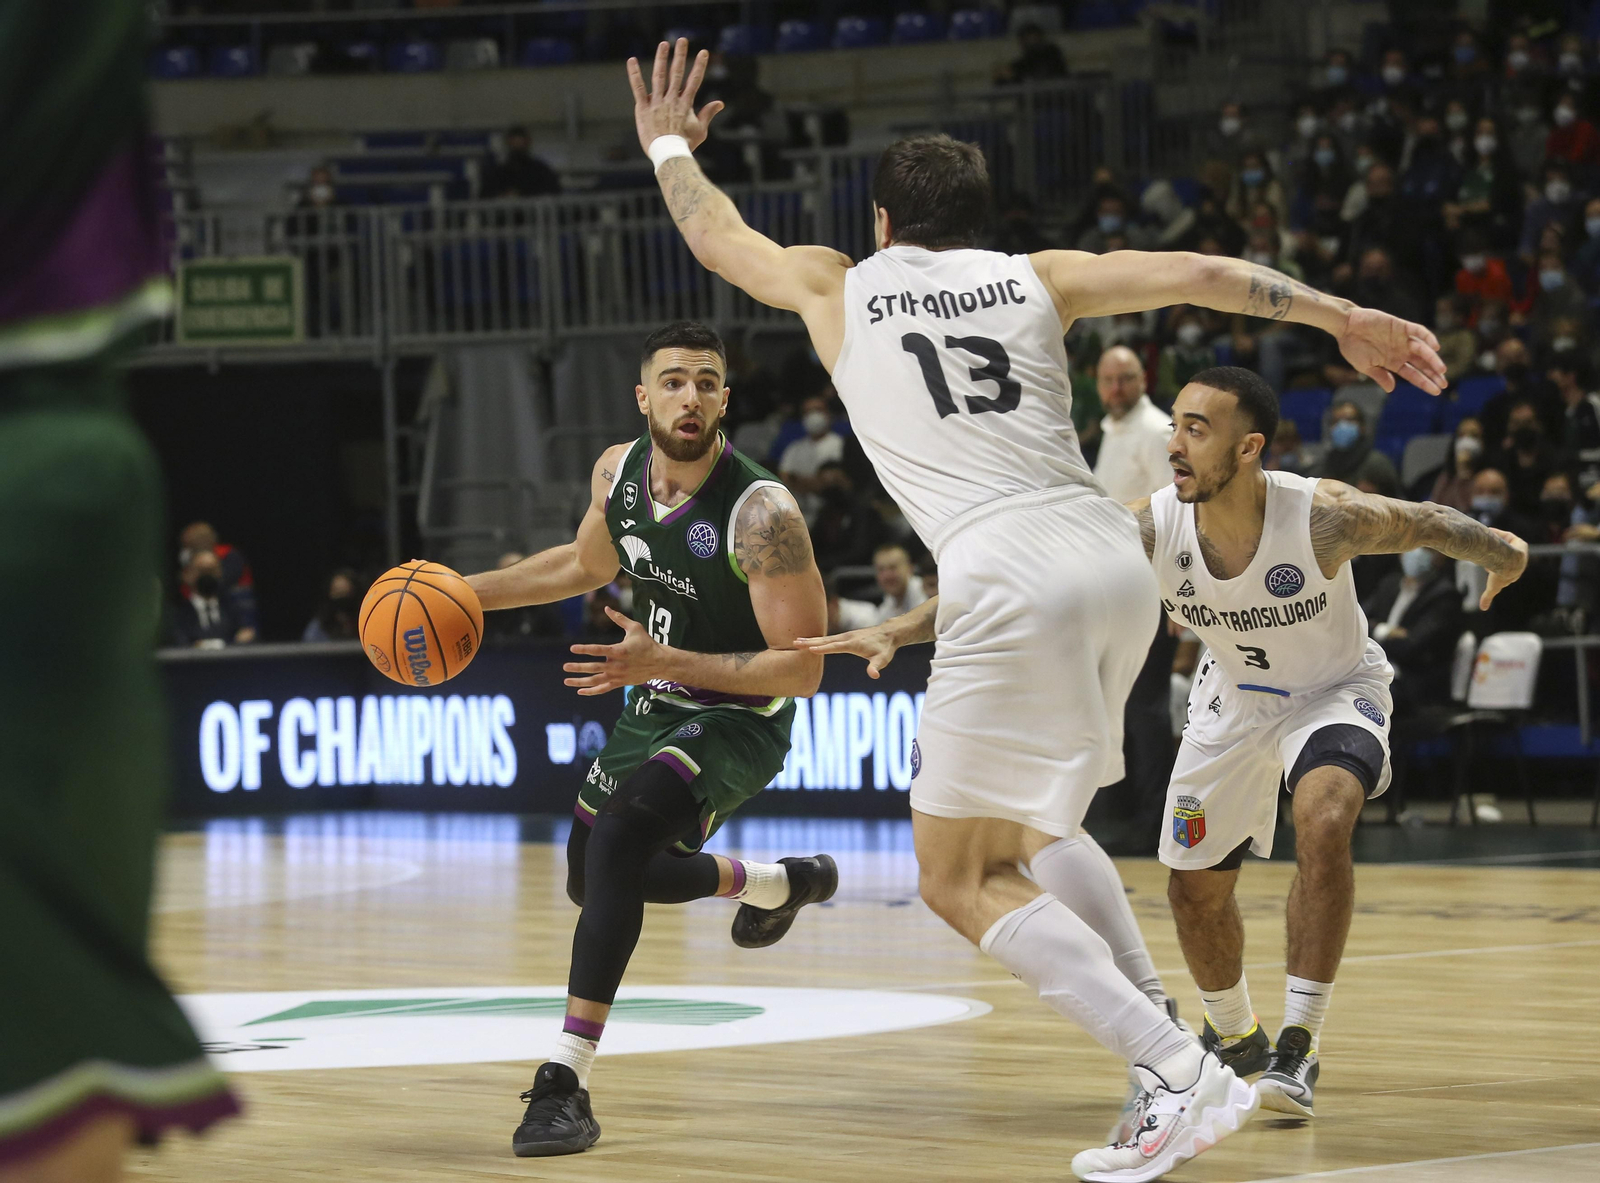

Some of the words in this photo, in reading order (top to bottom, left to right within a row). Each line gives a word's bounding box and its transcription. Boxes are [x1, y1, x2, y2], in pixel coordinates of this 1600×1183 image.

[901, 332, 1022, 419] 13
[649, 563, 697, 595] Unicaja
[1178, 603, 1222, 627] ANCA
[1219, 591, 1327, 632] TRANSILVANIA
[460, 632, 473, 658] FIBA
[1235, 643, 1271, 670] 3
[200, 700, 273, 793] OF
[277, 693, 518, 789] CHAMPIONS
[764, 691, 926, 791] AMPIO
